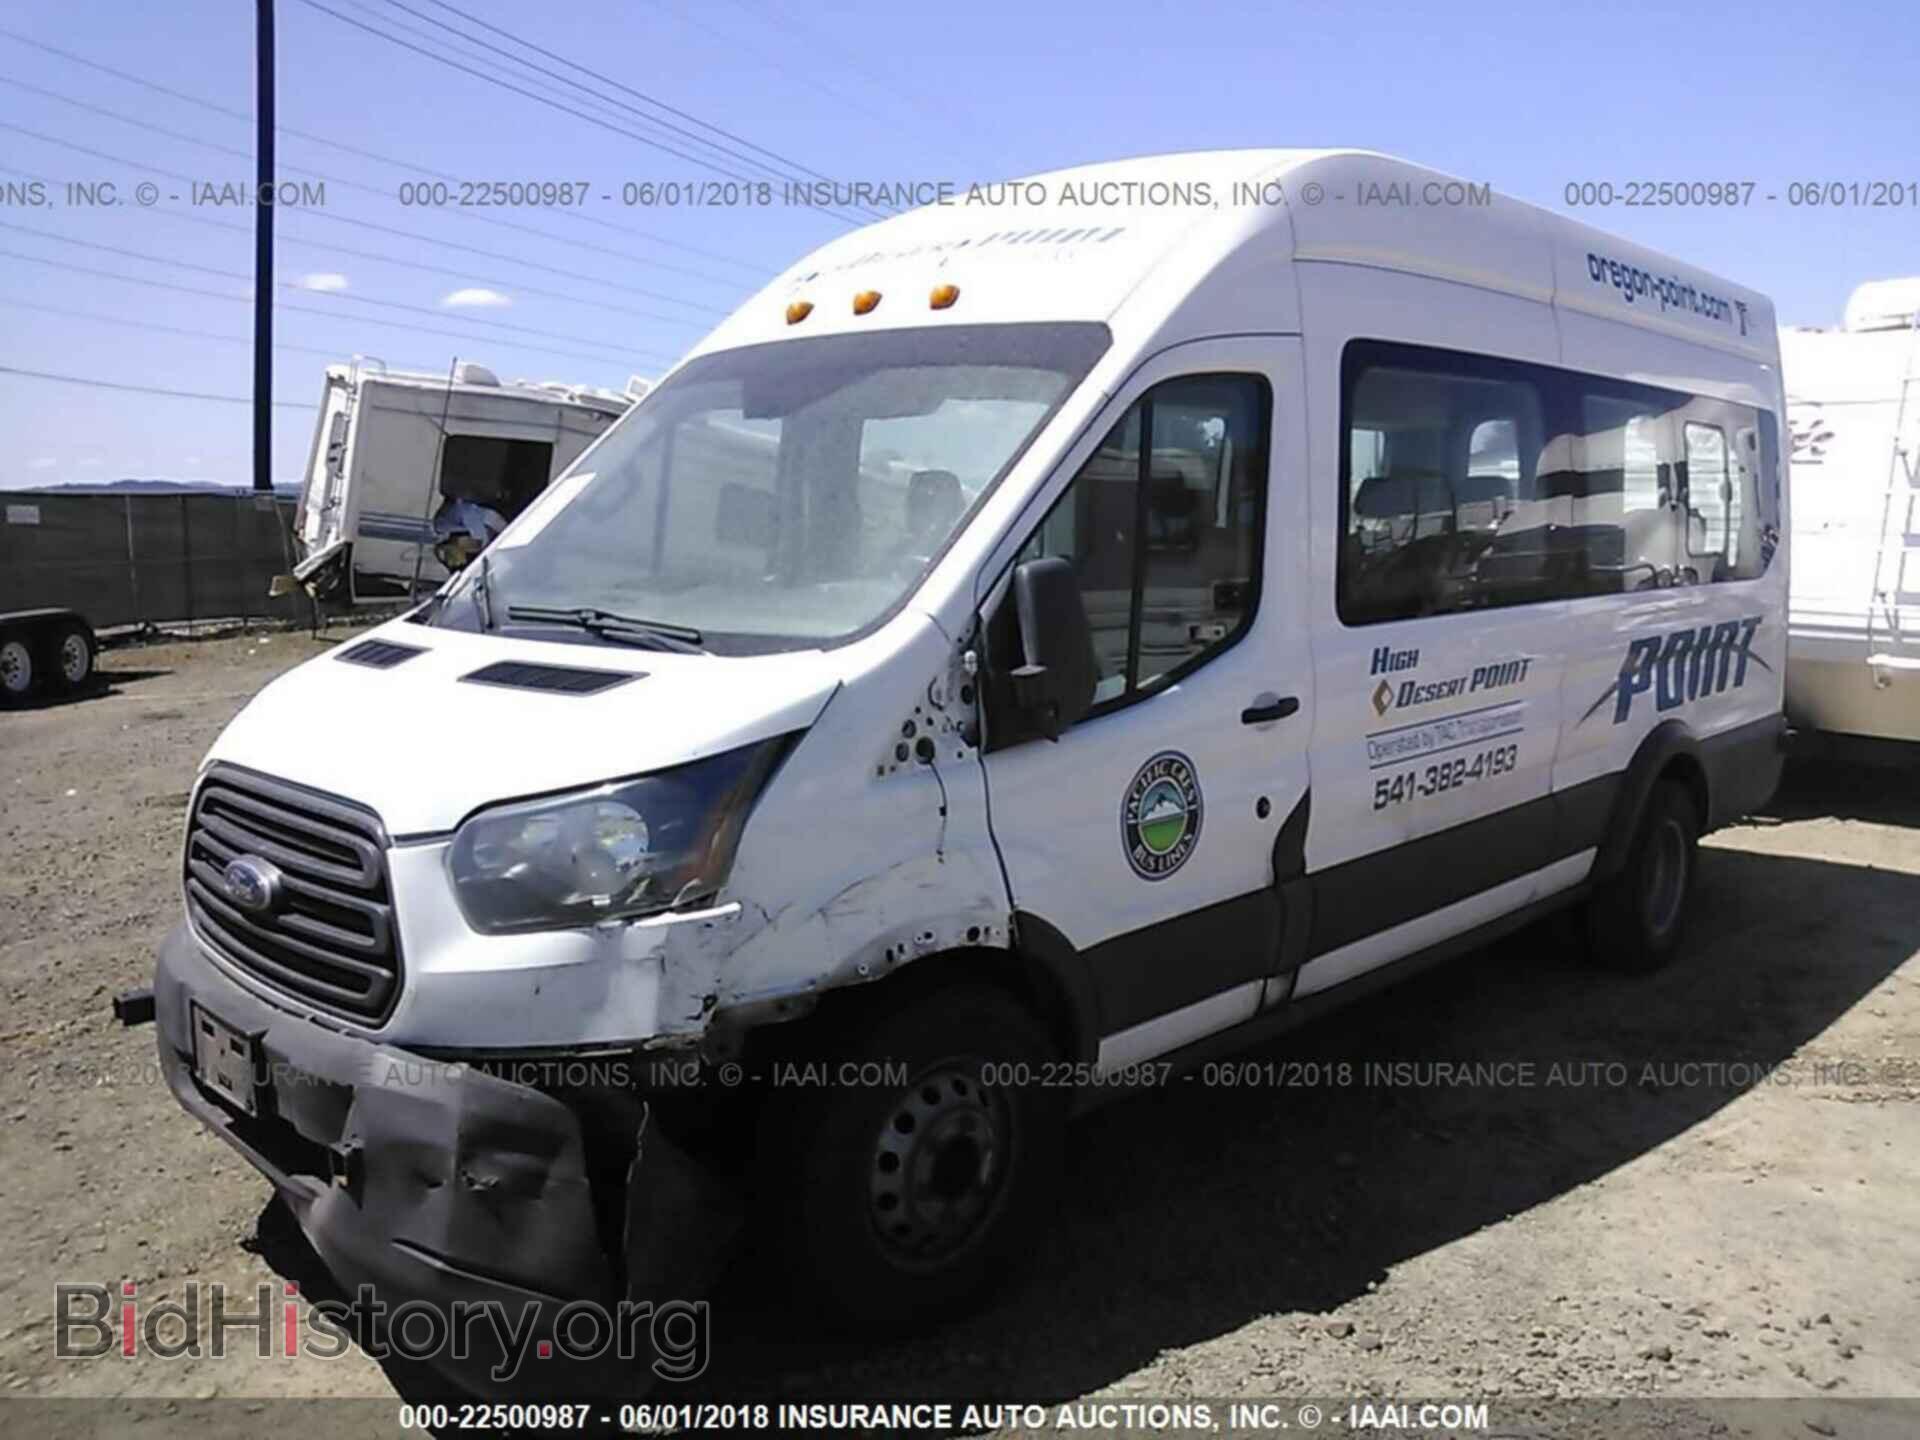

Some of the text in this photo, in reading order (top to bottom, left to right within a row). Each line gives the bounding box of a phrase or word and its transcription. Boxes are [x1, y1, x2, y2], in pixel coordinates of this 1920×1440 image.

[1587, 253, 1734, 325] oregon-point.com
[1469, 657, 1533, 693] POINT
[1612, 614, 1764, 725] POINT
[1373, 743, 1518, 811] 541-382-4193
